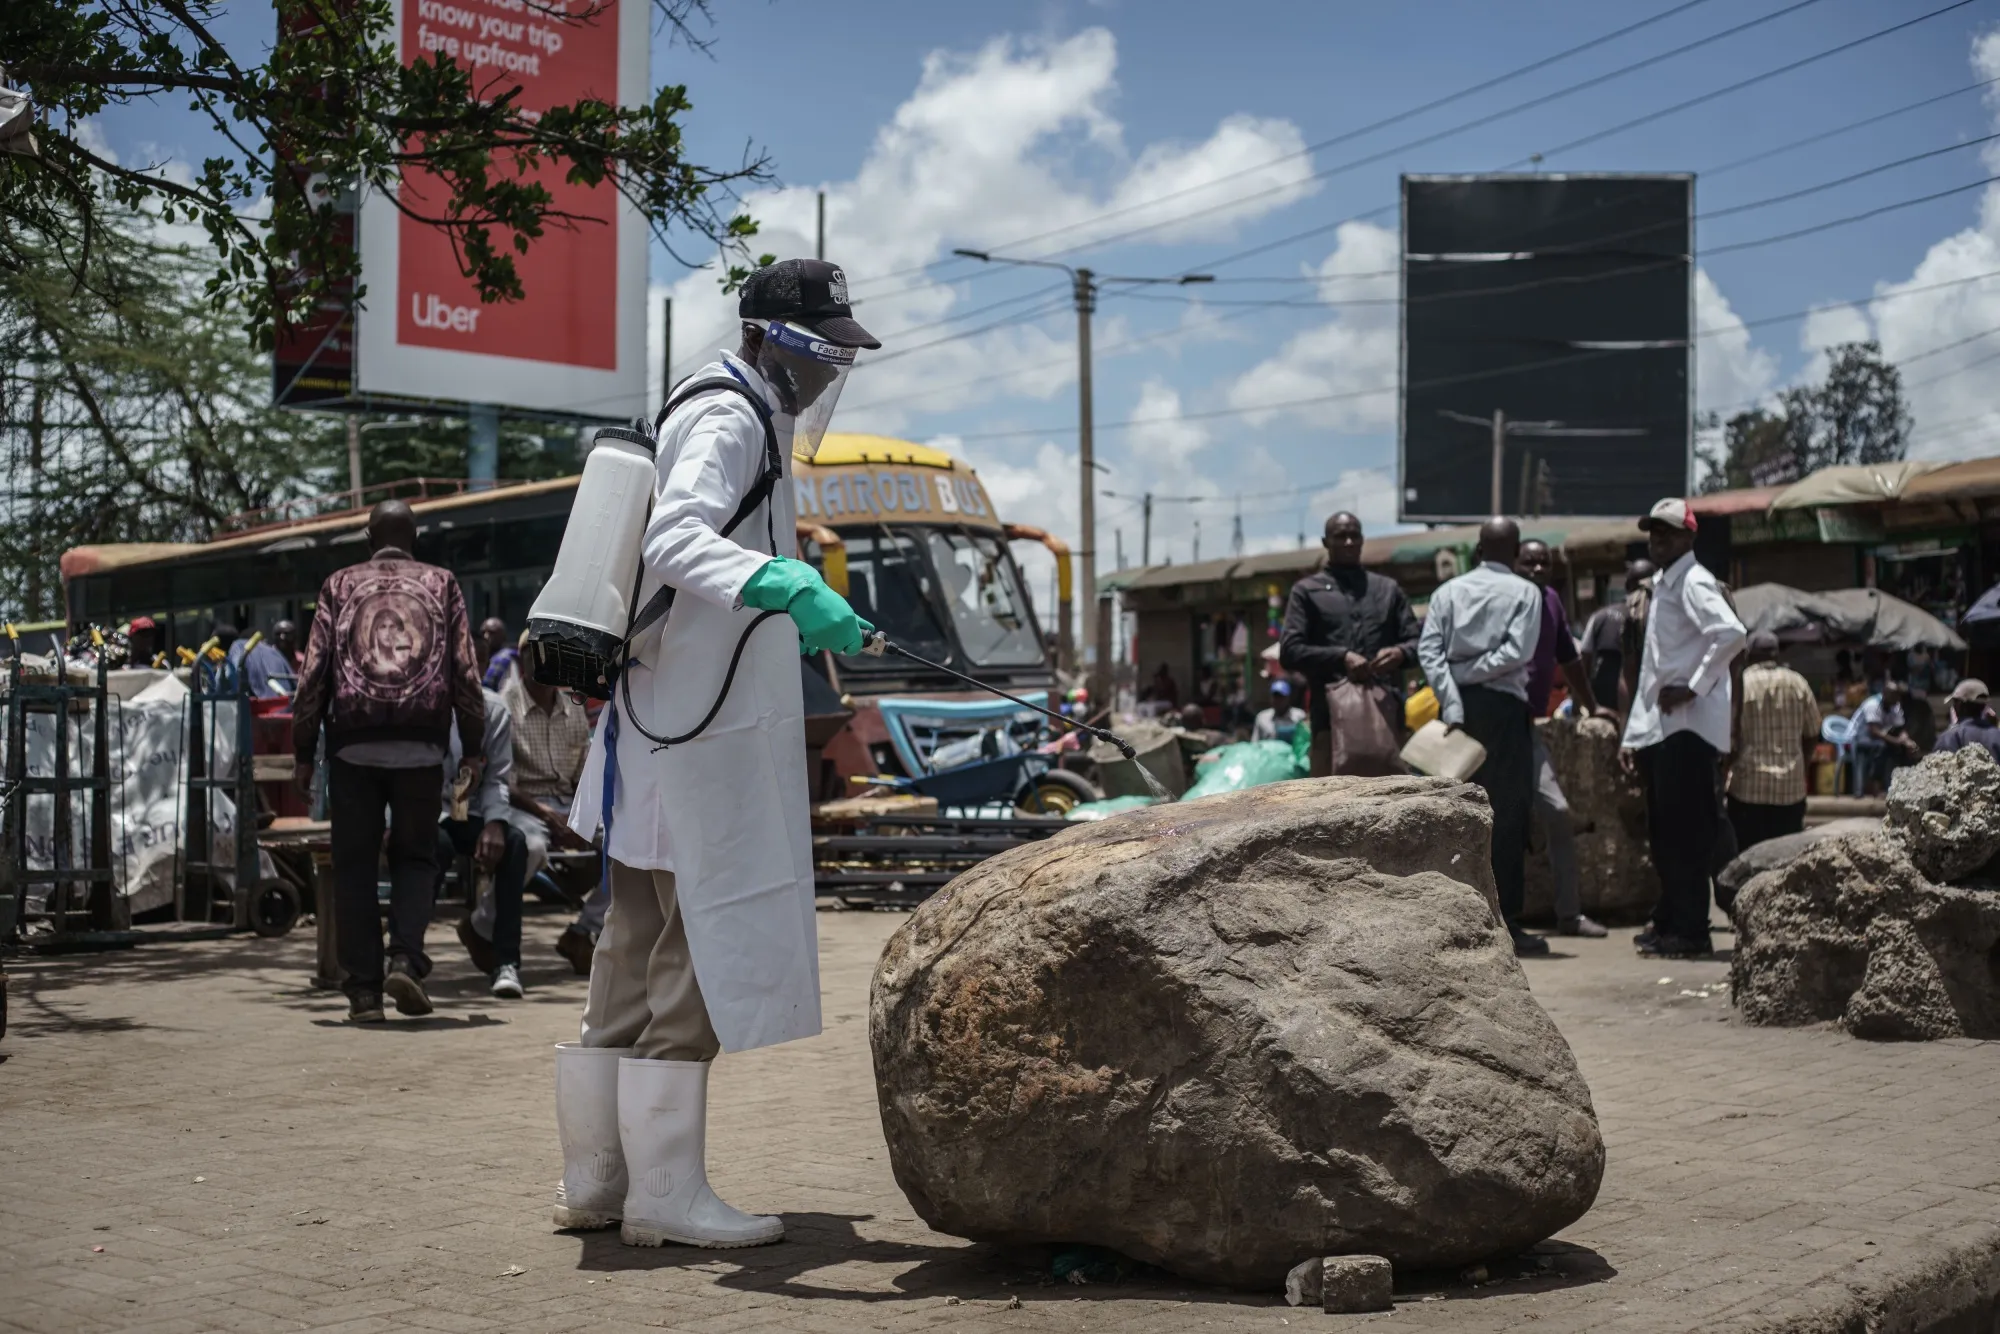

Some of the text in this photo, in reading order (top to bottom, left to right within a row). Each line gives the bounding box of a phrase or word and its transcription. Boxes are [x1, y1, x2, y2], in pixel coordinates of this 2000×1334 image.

[418, 0, 563, 55] know your trip
[418, 24, 540, 76] fare upfront
[411, 293, 480, 334] Uber
[817, 344, 838, 356] Face
[793, 472, 987, 519] NAIROBI BUS
